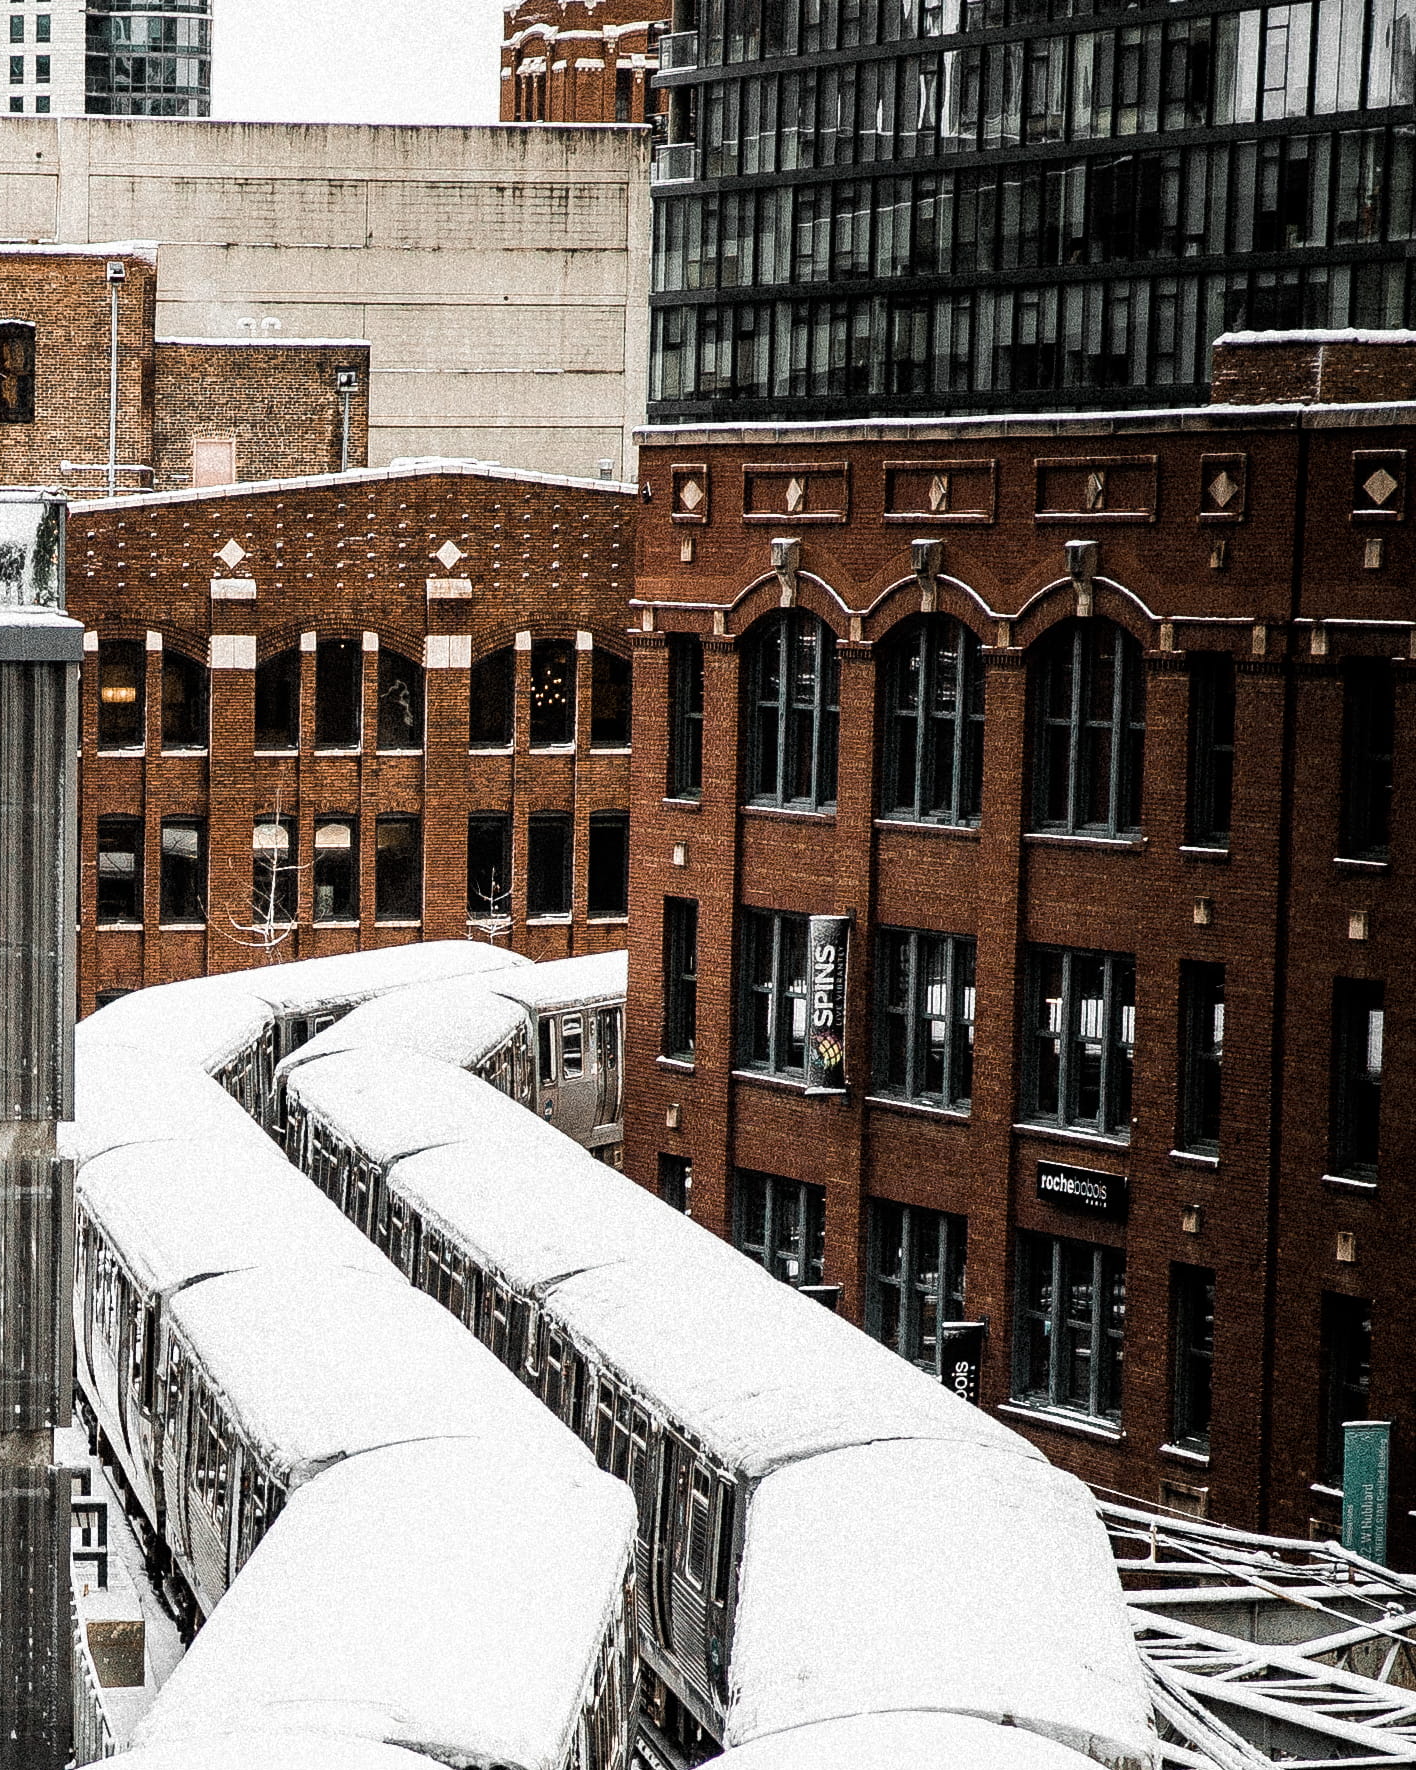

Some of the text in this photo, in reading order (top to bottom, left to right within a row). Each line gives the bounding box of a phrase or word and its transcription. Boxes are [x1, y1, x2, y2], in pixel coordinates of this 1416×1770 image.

[813, 944, 836, 1027] SPINS
[1040, 1172, 1107, 1200] rochebobois
[1361, 1483, 1374, 1530] Hubbard
